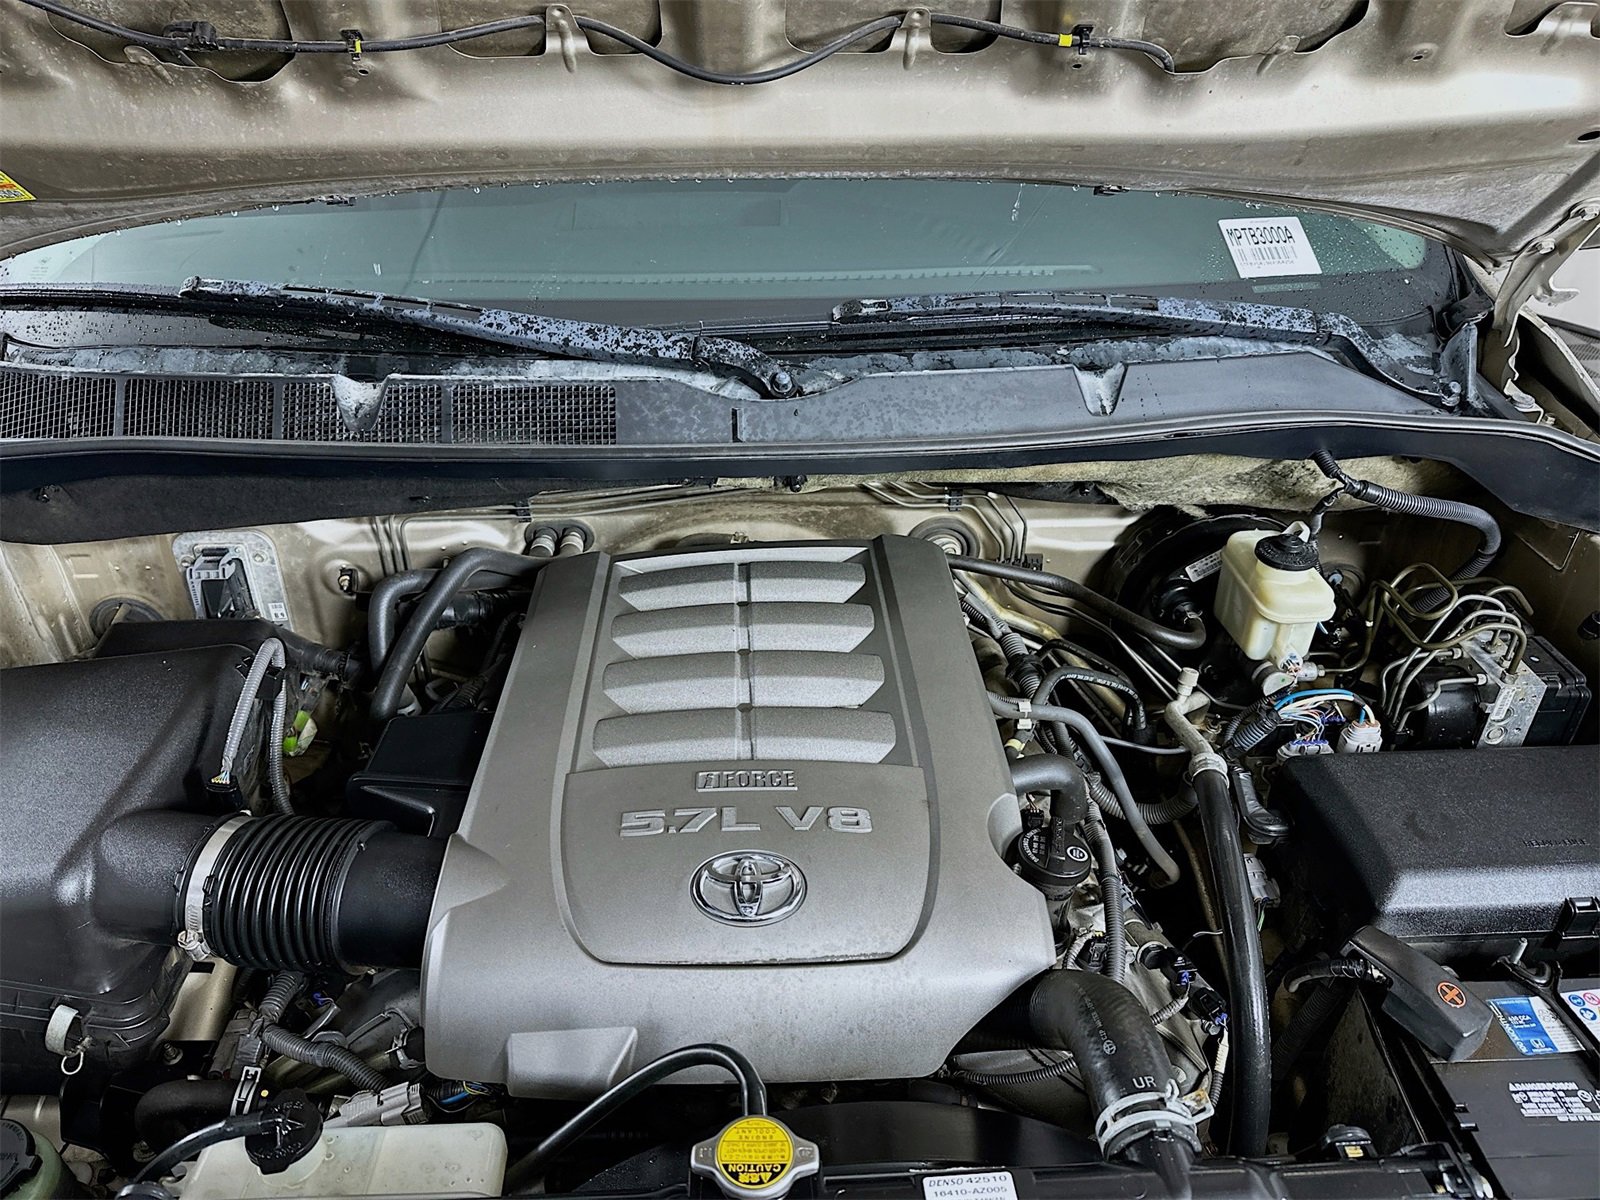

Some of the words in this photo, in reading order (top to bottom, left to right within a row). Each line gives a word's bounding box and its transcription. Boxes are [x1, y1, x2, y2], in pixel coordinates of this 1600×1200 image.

[1226, 226, 1296, 247] MPTB3000A
[620, 806, 761, 837] 5.7L
[776, 806, 873, 834] V8
[1497, 1015, 1521, 1041] MONTH
[1132, 1075, 1157, 1089] UR
[728, 1163, 781, 1173] CAUTION
[928, 1177, 964, 1188] DENSO
[965, 1175, 1007, 1184] 42510
